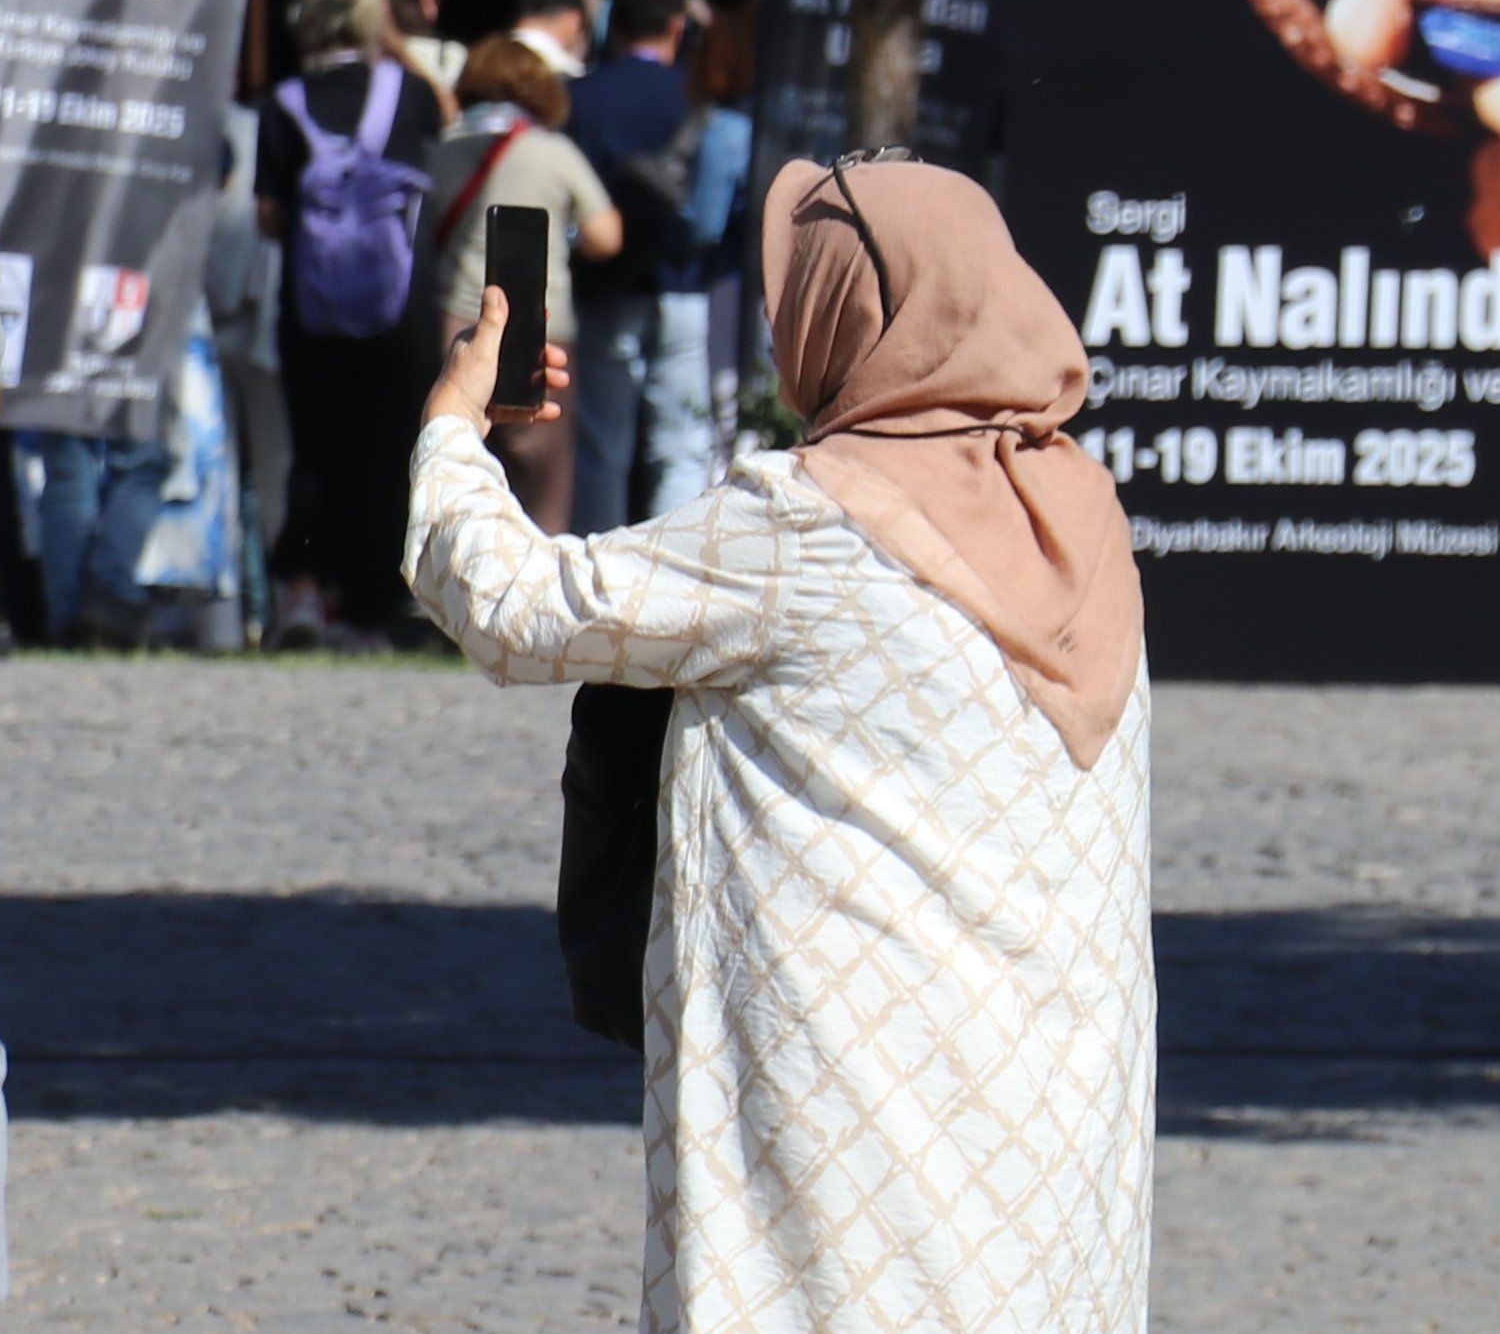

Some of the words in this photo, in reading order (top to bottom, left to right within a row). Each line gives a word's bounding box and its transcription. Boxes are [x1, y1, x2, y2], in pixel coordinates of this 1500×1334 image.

[1086, 189, 1187, 242] Sergi
[1081, 244, 1192, 349] At
[1191, 355, 1456, 411] Kaymakamlığı
[1223, 425, 1347, 485] Ekim
[1352, 428, 1477, 488] 2025
